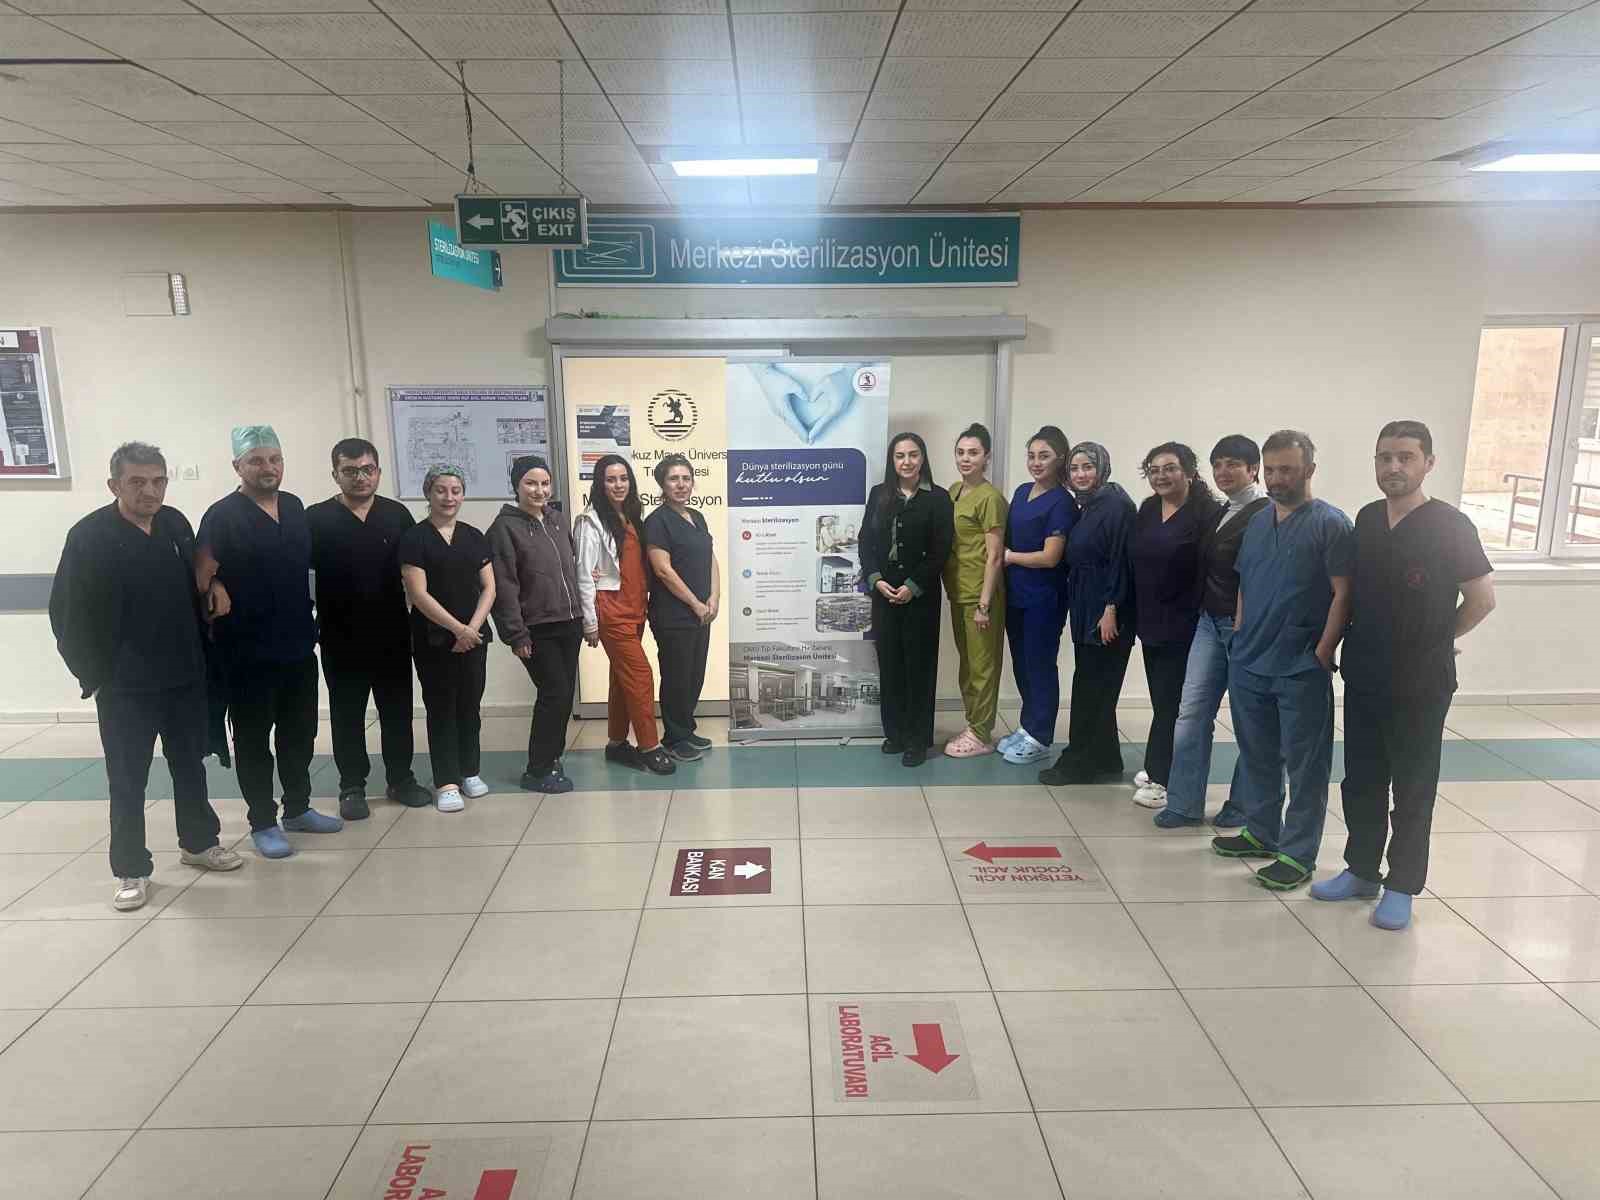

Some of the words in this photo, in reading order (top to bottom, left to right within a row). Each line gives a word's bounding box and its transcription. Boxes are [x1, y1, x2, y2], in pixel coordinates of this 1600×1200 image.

[532, 207, 576, 222] ÇIKIŞ
[537, 224, 575, 236] EXIT
[671, 239, 762, 268] Merkezi
[771, 238, 920, 276] Sterilizasyon
[929, 232, 1009, 267] Ünitesi
[688, 448, 728, 460] Ünivers
[742, 461, 768, 474] Dünya
[770, 461, 820, 473] sterilizasyon
[822, 460, 844, 472] günü
[681, 851, 704, 893] BANKASI
[707, 859, 728, 880] KAN
[1013, 864, 1073, 873] ÇOCUK
[839, 1005, 869, 1097] LABORATUVARI
[869, 1034, 899, 1063] ACİL
